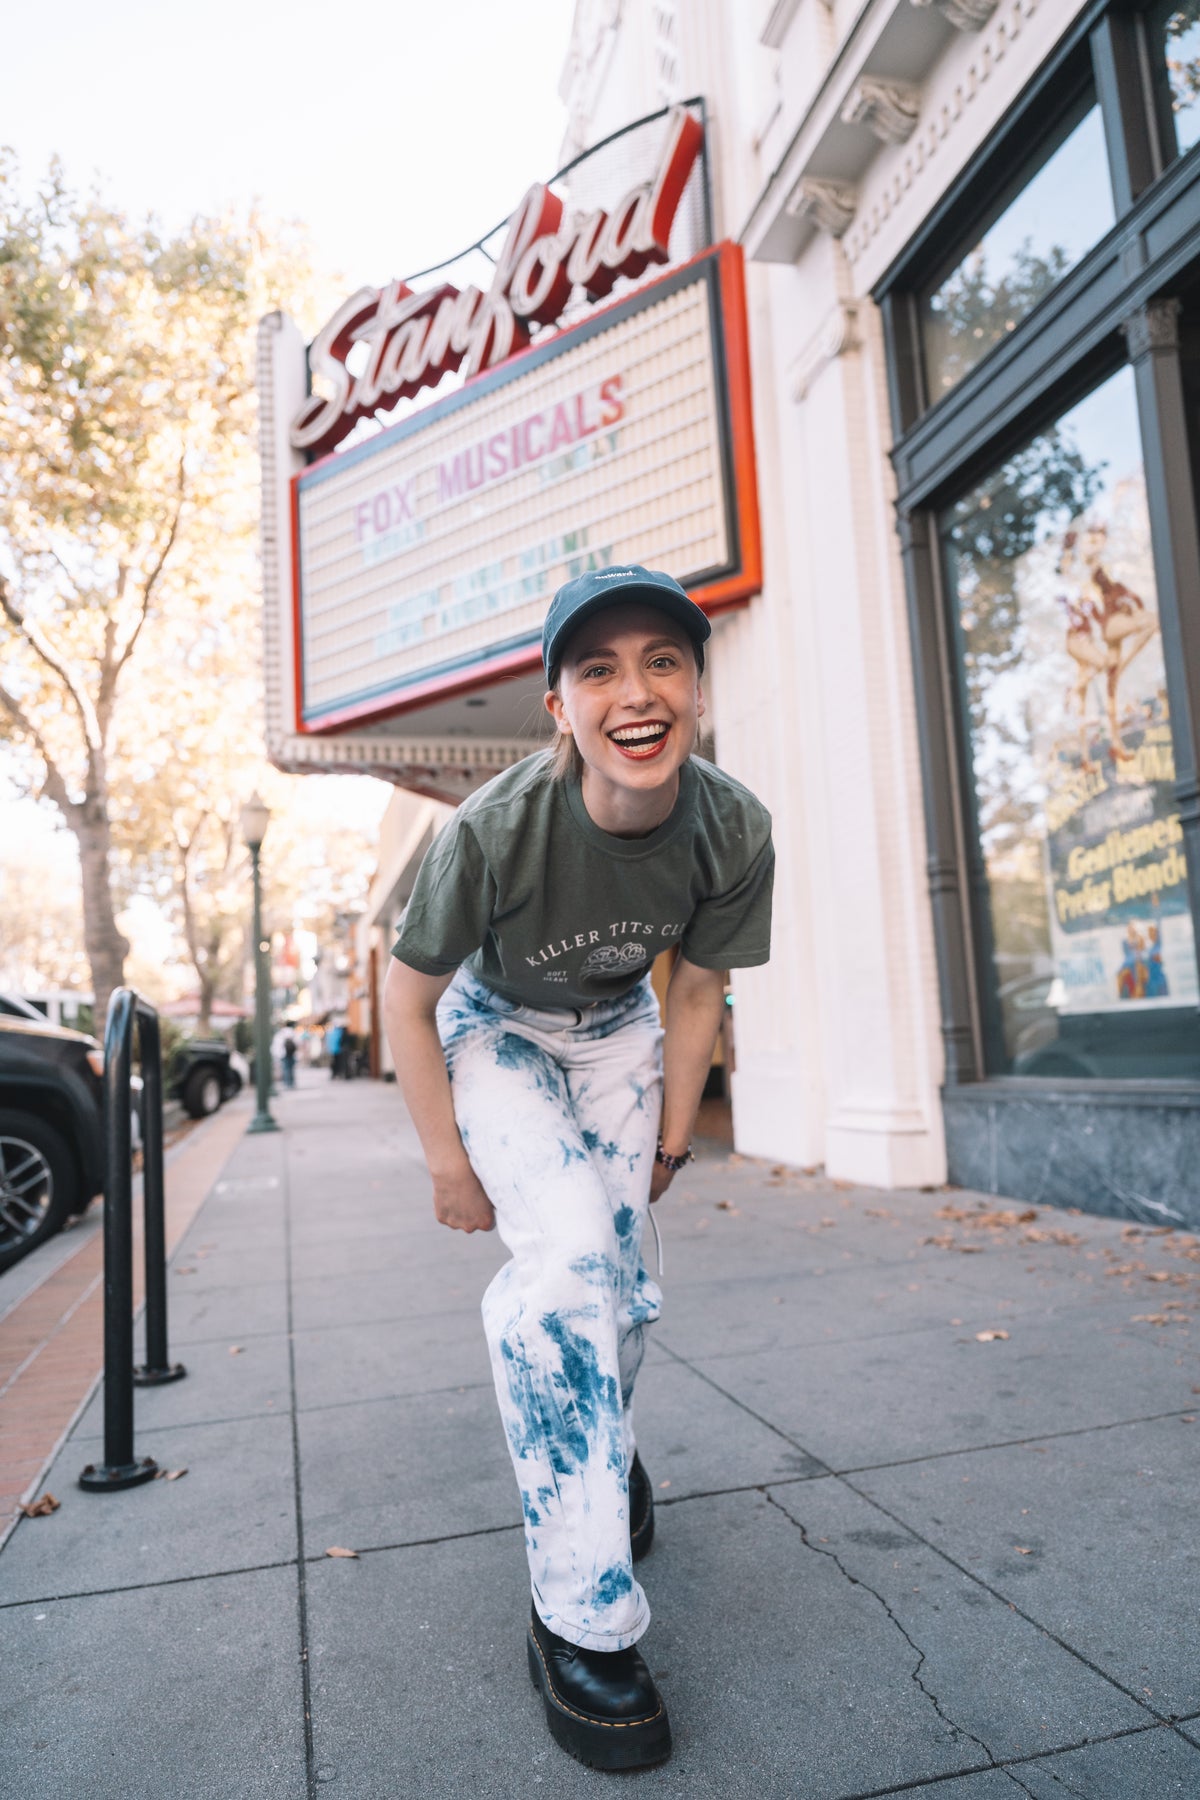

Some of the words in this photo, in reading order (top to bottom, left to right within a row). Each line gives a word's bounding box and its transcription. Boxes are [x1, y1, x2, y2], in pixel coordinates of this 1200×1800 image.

[291, 104, 703, 453] Stanford
[353, 478, 417, 542] FOX
[436, 374, 626, 503] MUSICALS
[525, 930, 601, 967] KILLER
[609, 921, 654, 938] TITS
